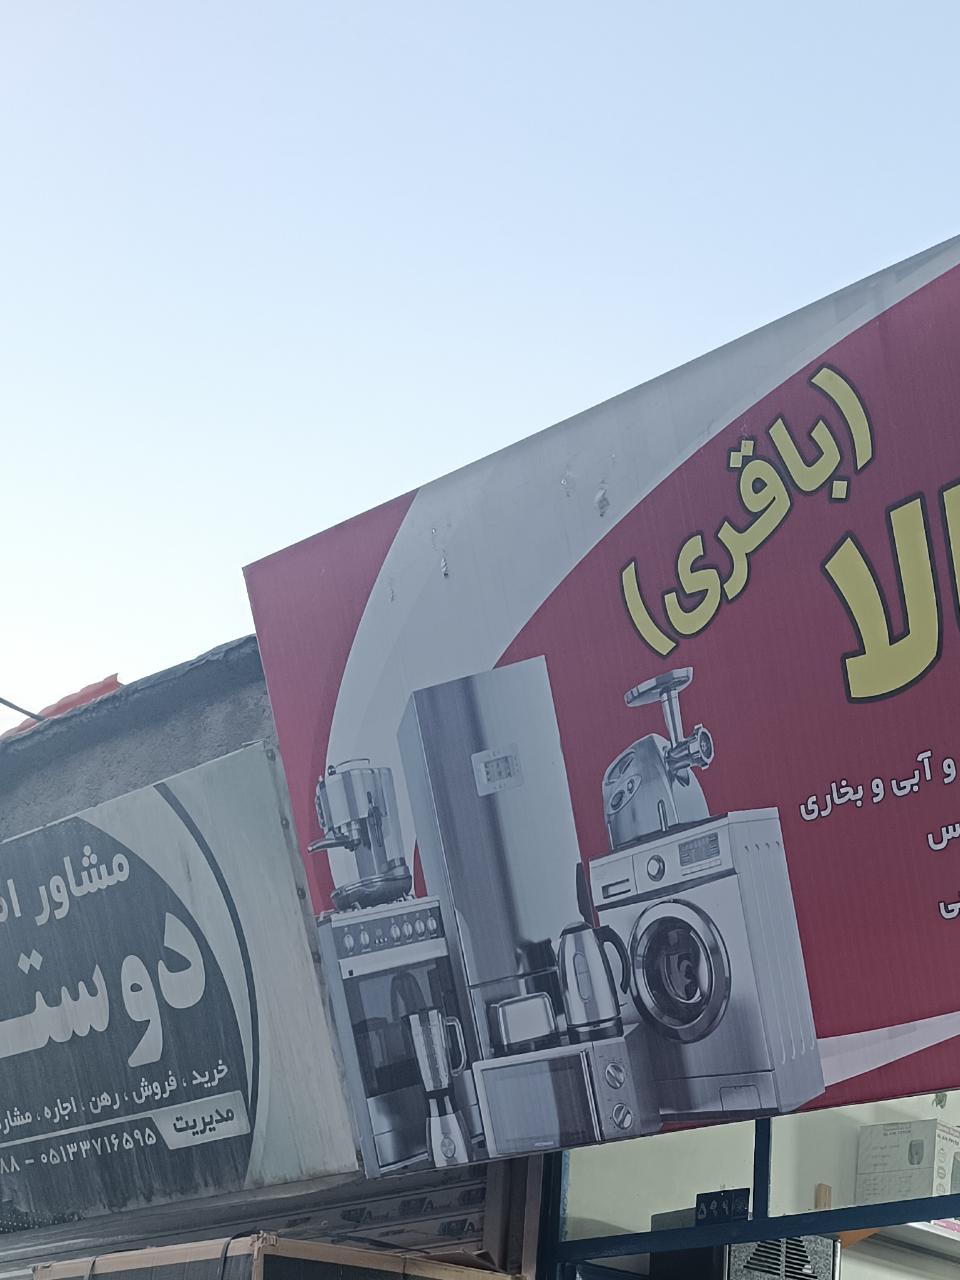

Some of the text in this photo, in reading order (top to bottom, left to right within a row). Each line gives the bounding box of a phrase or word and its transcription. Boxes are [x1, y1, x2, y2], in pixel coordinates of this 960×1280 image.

[621, 365, 873, 657] (باقری)
[870, 777, 885, 804] و
[891, 751, 932, 798] آبی
[943, 759, 957, 784] و
[799, 779, 864, 821] بخاری
[35, 845, 130, 926] مشاور
[172, 1107, 235, 1137] مدیریت
